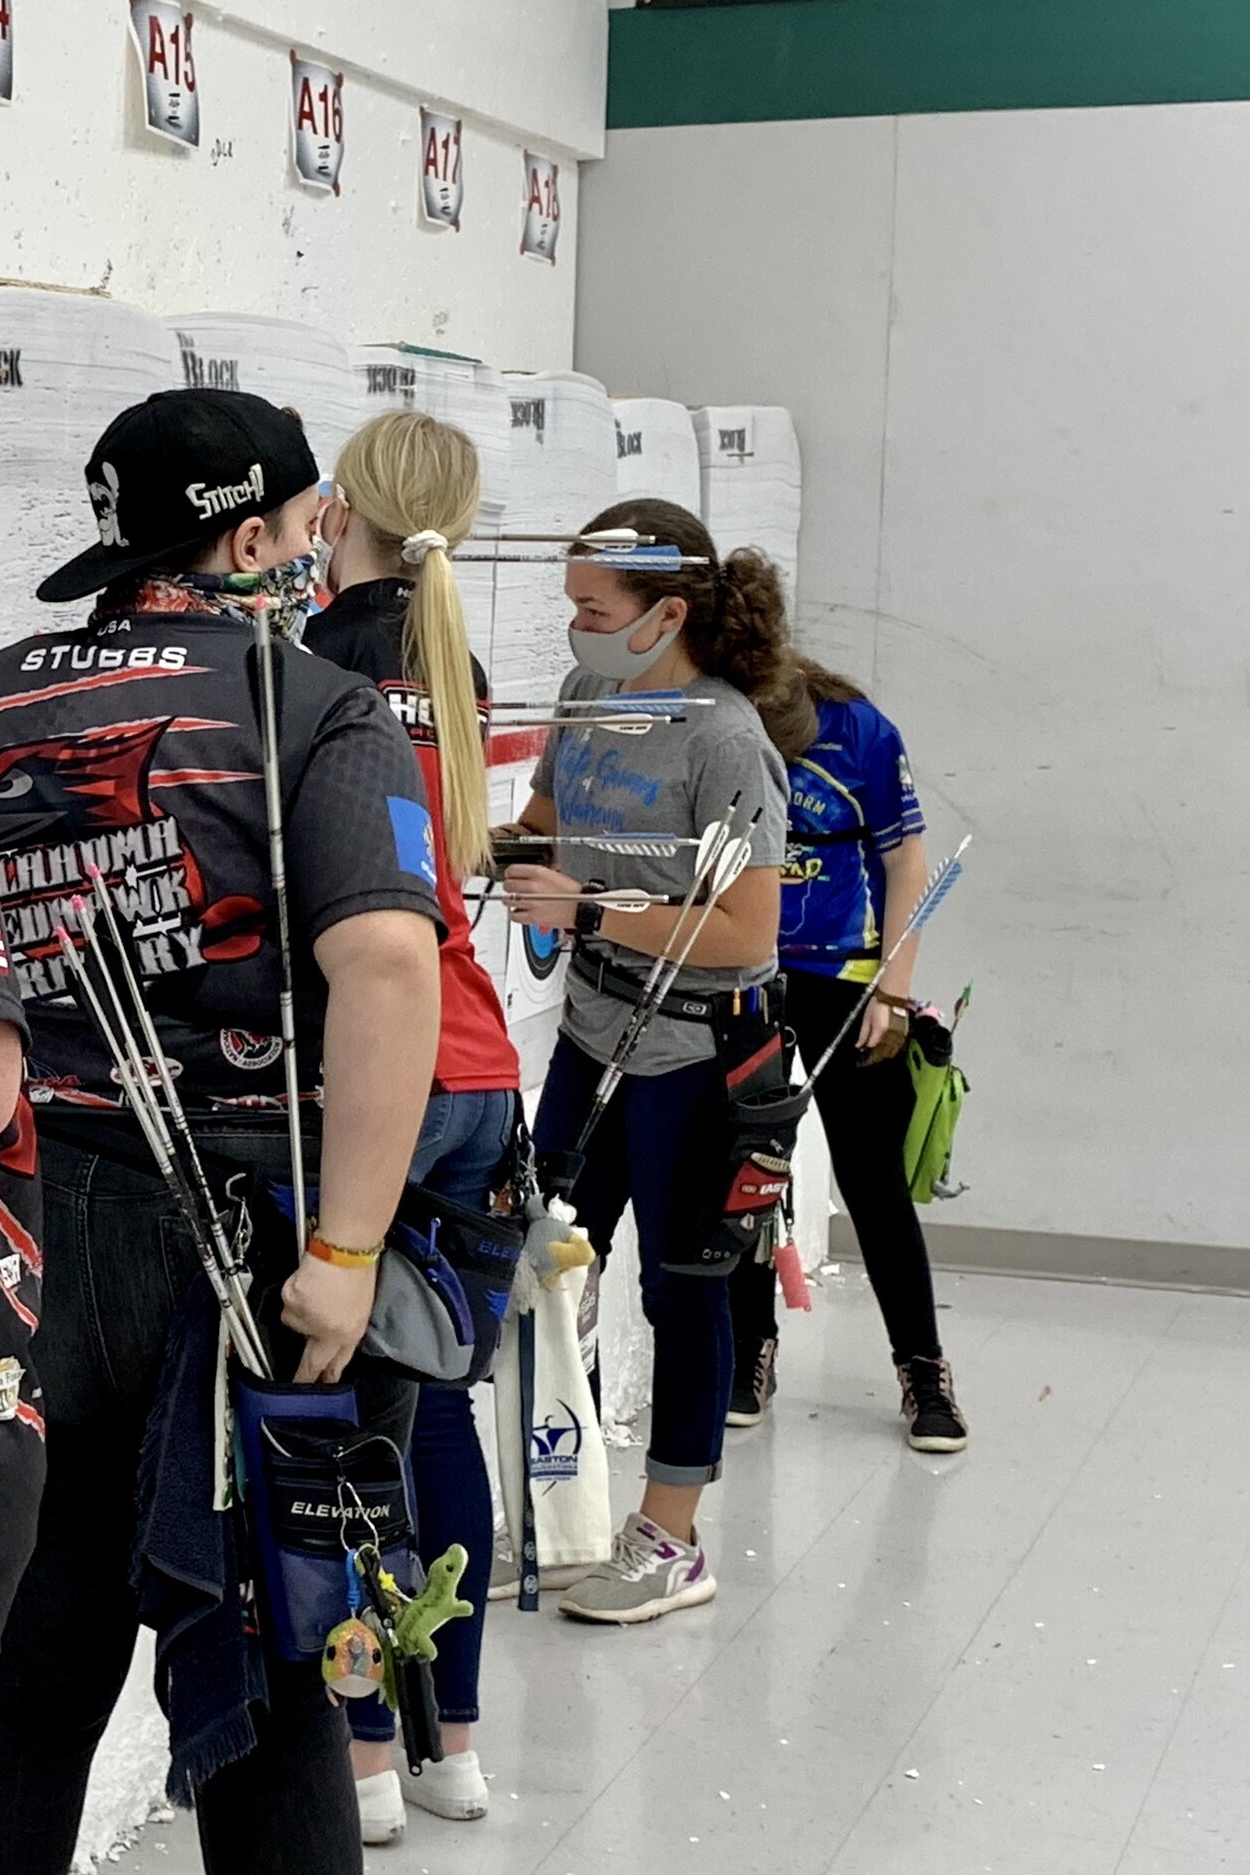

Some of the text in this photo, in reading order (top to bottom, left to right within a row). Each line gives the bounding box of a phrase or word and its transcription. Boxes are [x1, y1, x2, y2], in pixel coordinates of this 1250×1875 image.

[149, 16, 196, 92] A15
[298, 77, 342, 143] A16
[424, 127, 460, 184] A17
[181, 349, 240, 392] BLOCK
[97, 618, 131, 636] USA
[20, 644, 187, 671] STUBBS
[291, 1501, 390, 1519] ELEVATION
